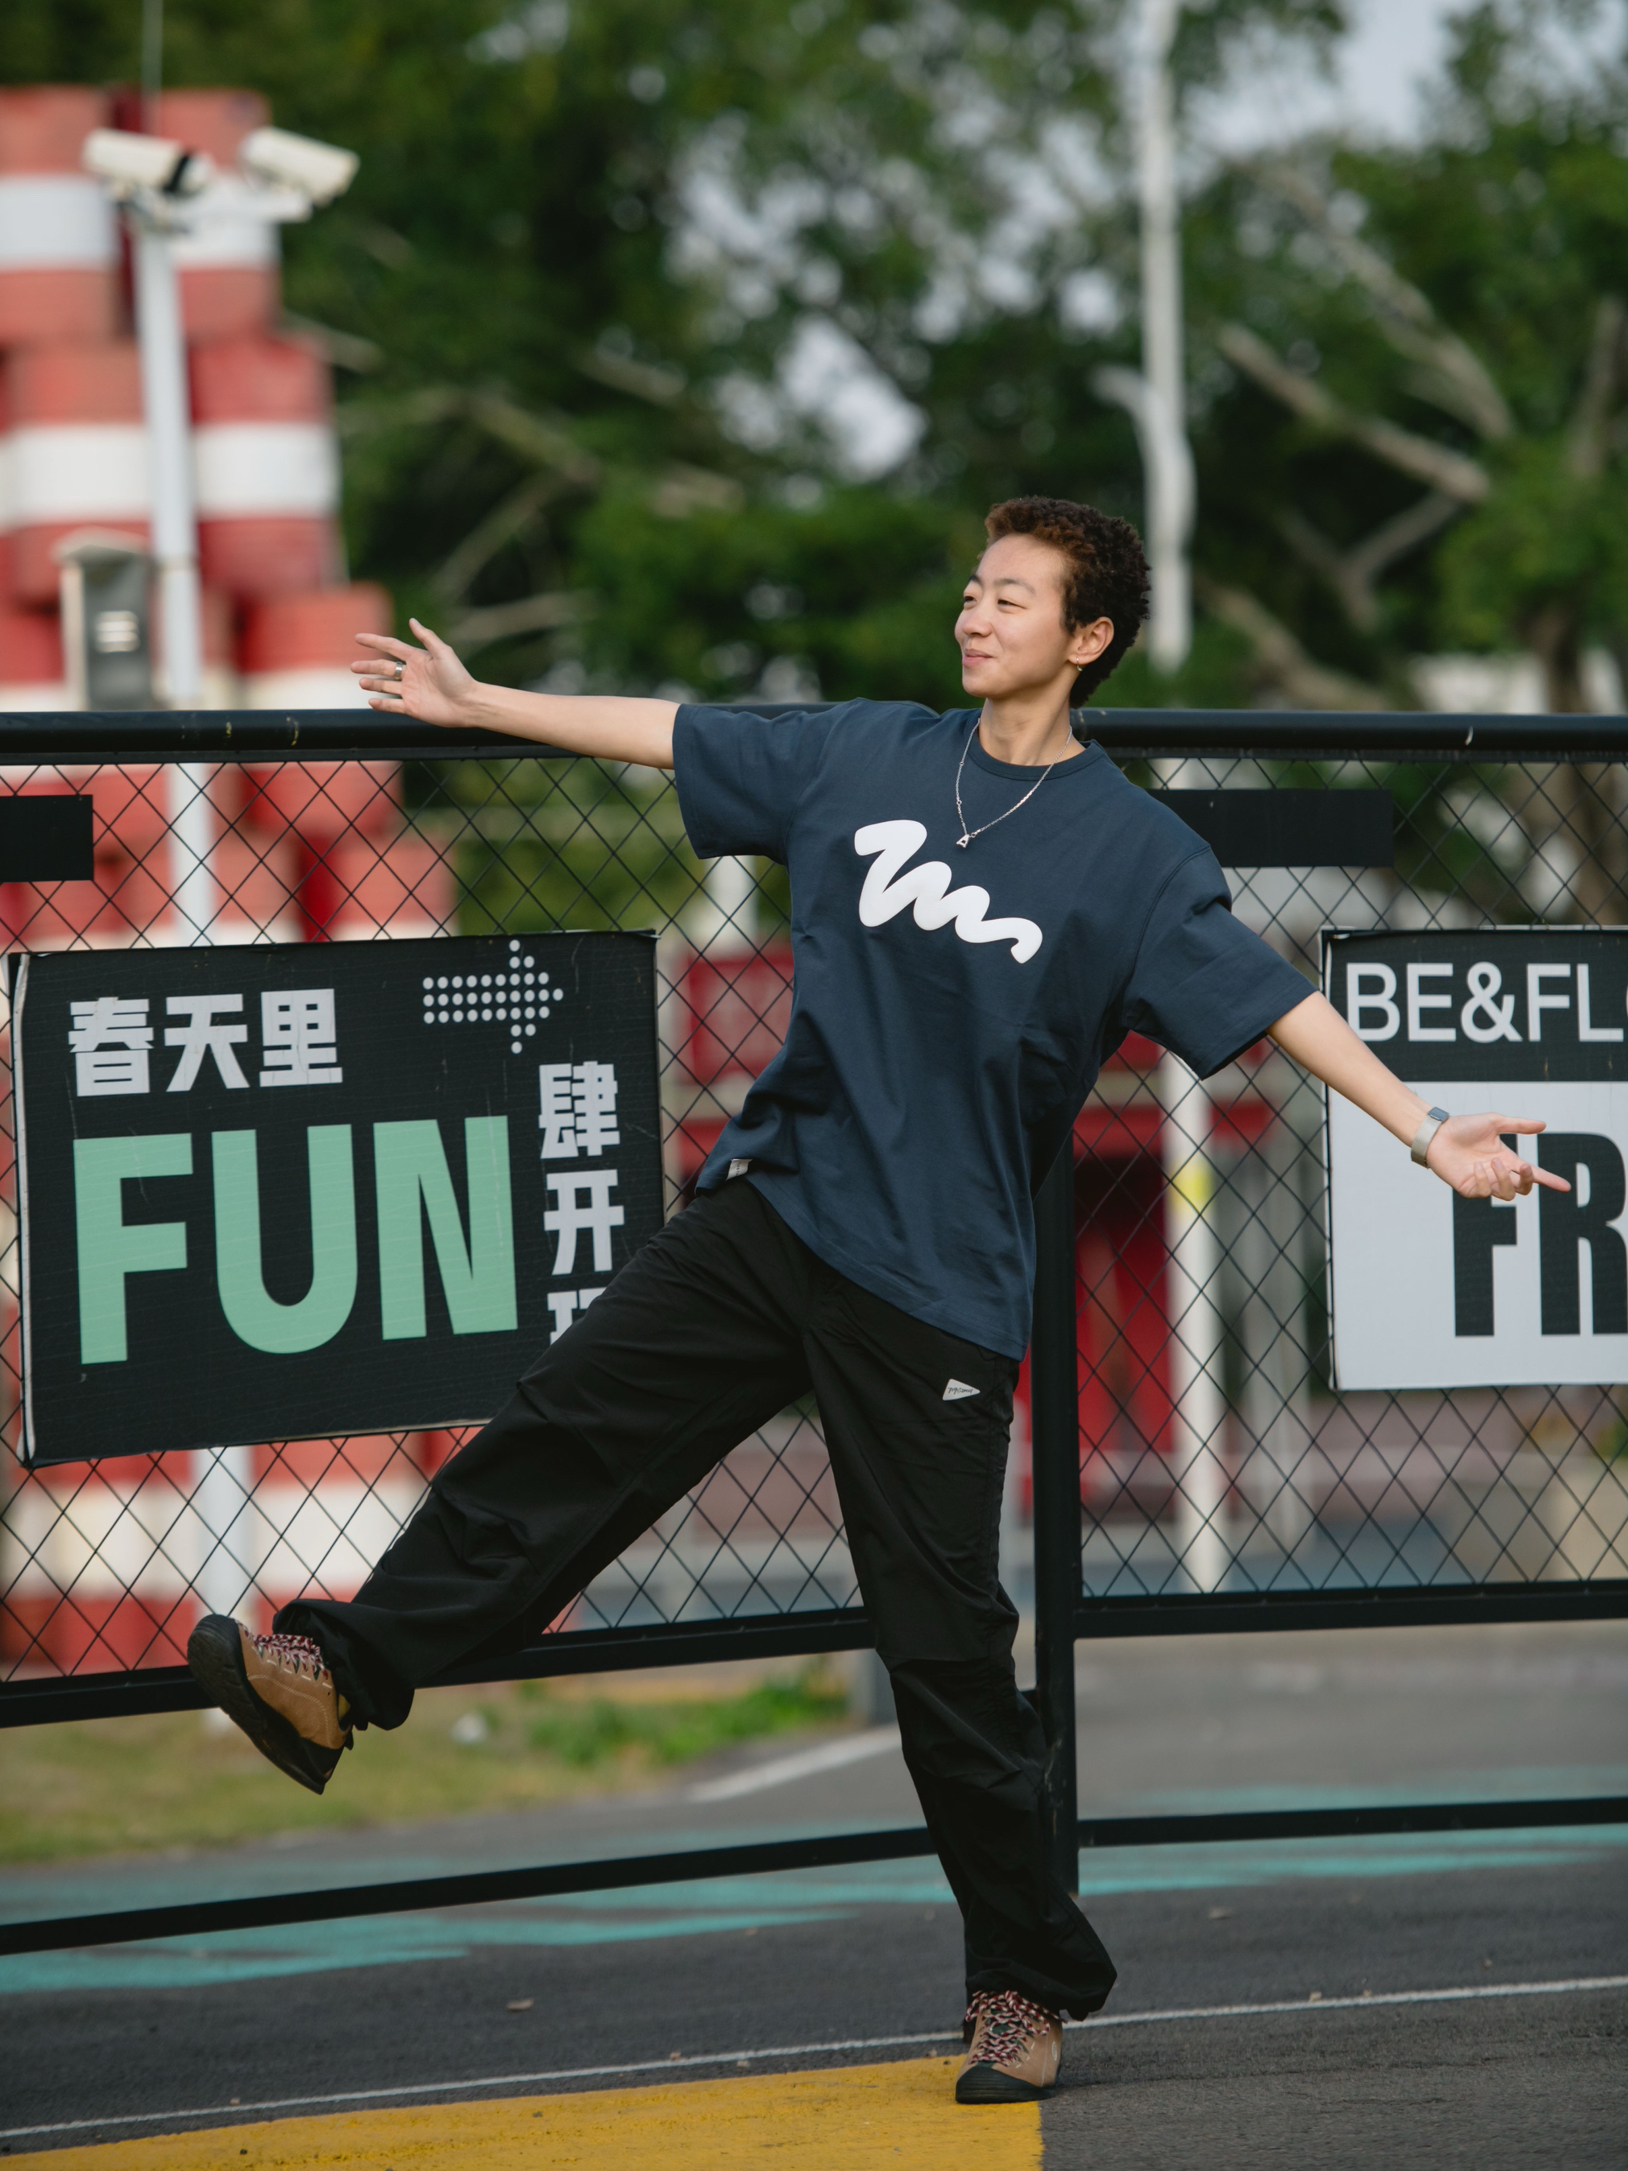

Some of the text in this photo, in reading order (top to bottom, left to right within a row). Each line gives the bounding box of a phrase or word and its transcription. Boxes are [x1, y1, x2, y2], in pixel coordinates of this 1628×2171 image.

[68, 988, 343, 1096] 春天里
[1346, 962, 1628, 1042] BE&FL
[73, 1115, 518, 1364] FUN
